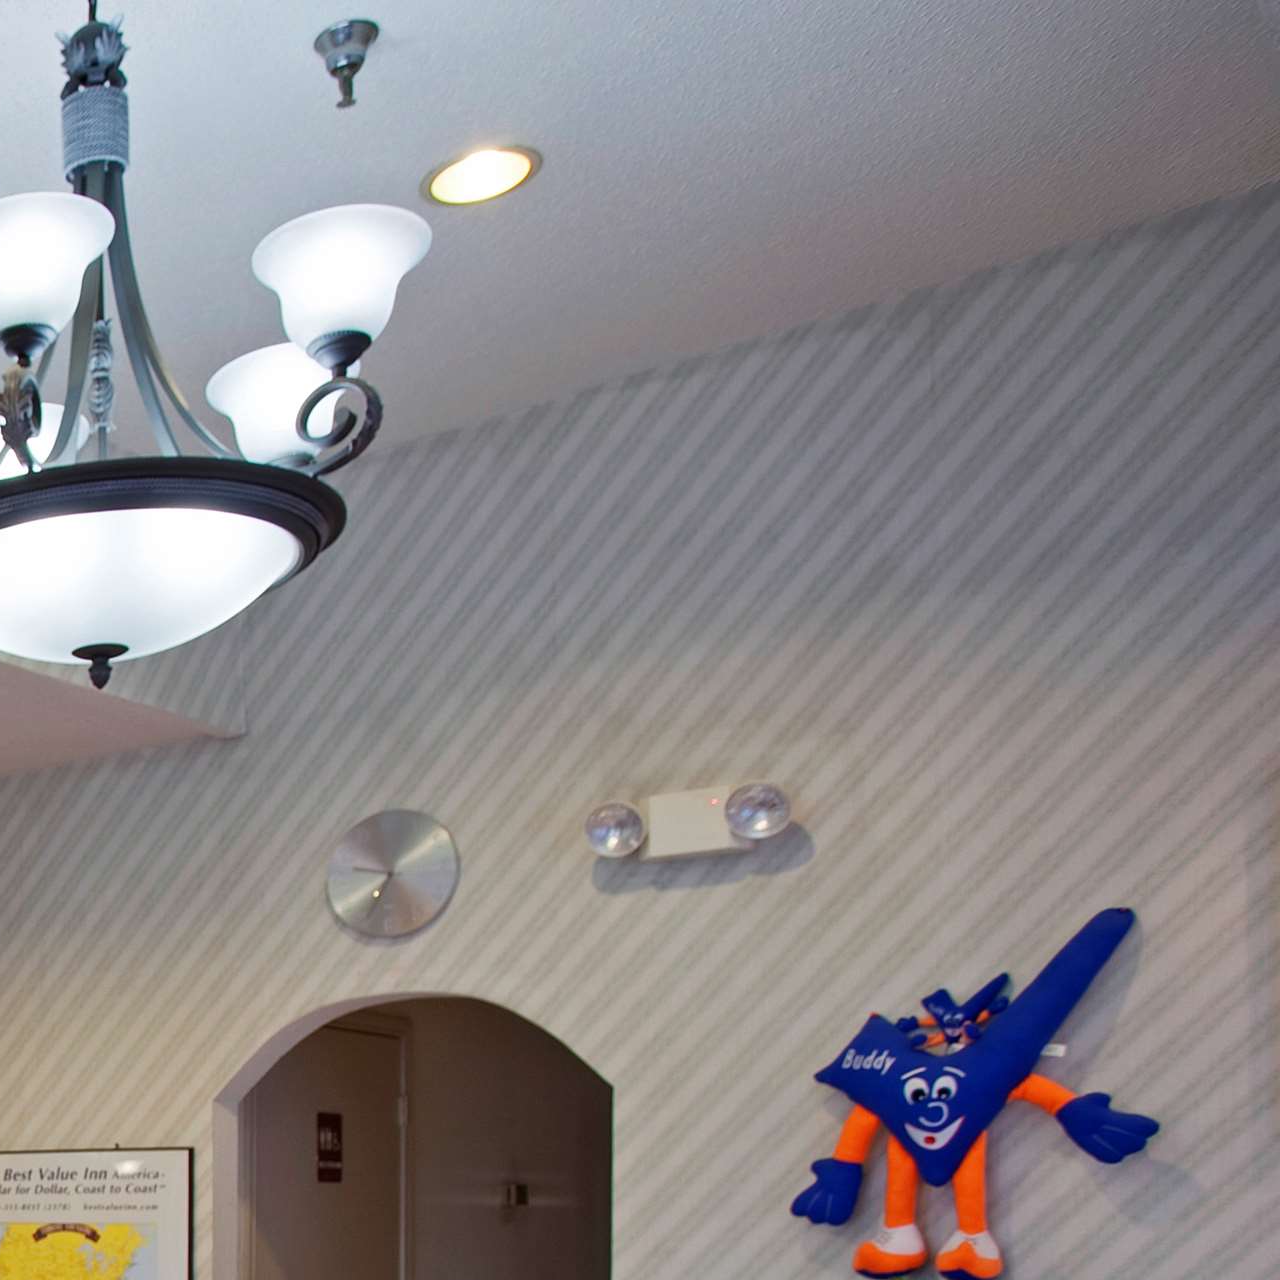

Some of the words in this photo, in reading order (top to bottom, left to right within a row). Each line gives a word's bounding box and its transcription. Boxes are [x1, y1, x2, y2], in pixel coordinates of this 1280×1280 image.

[841, 1048, 897, 1075] Buddy
[3, 1168, 33, 1182] Best
[39, 1167, 78, 1181] Value
[84, 1168, 108, 1180] Inn
[16, 1184, 31, 1195] for
[35, 1184, 71, 1196] Dollar,
[75, 1184, 106, 1195] Coast
[110, 1184, 121, 1194] to
